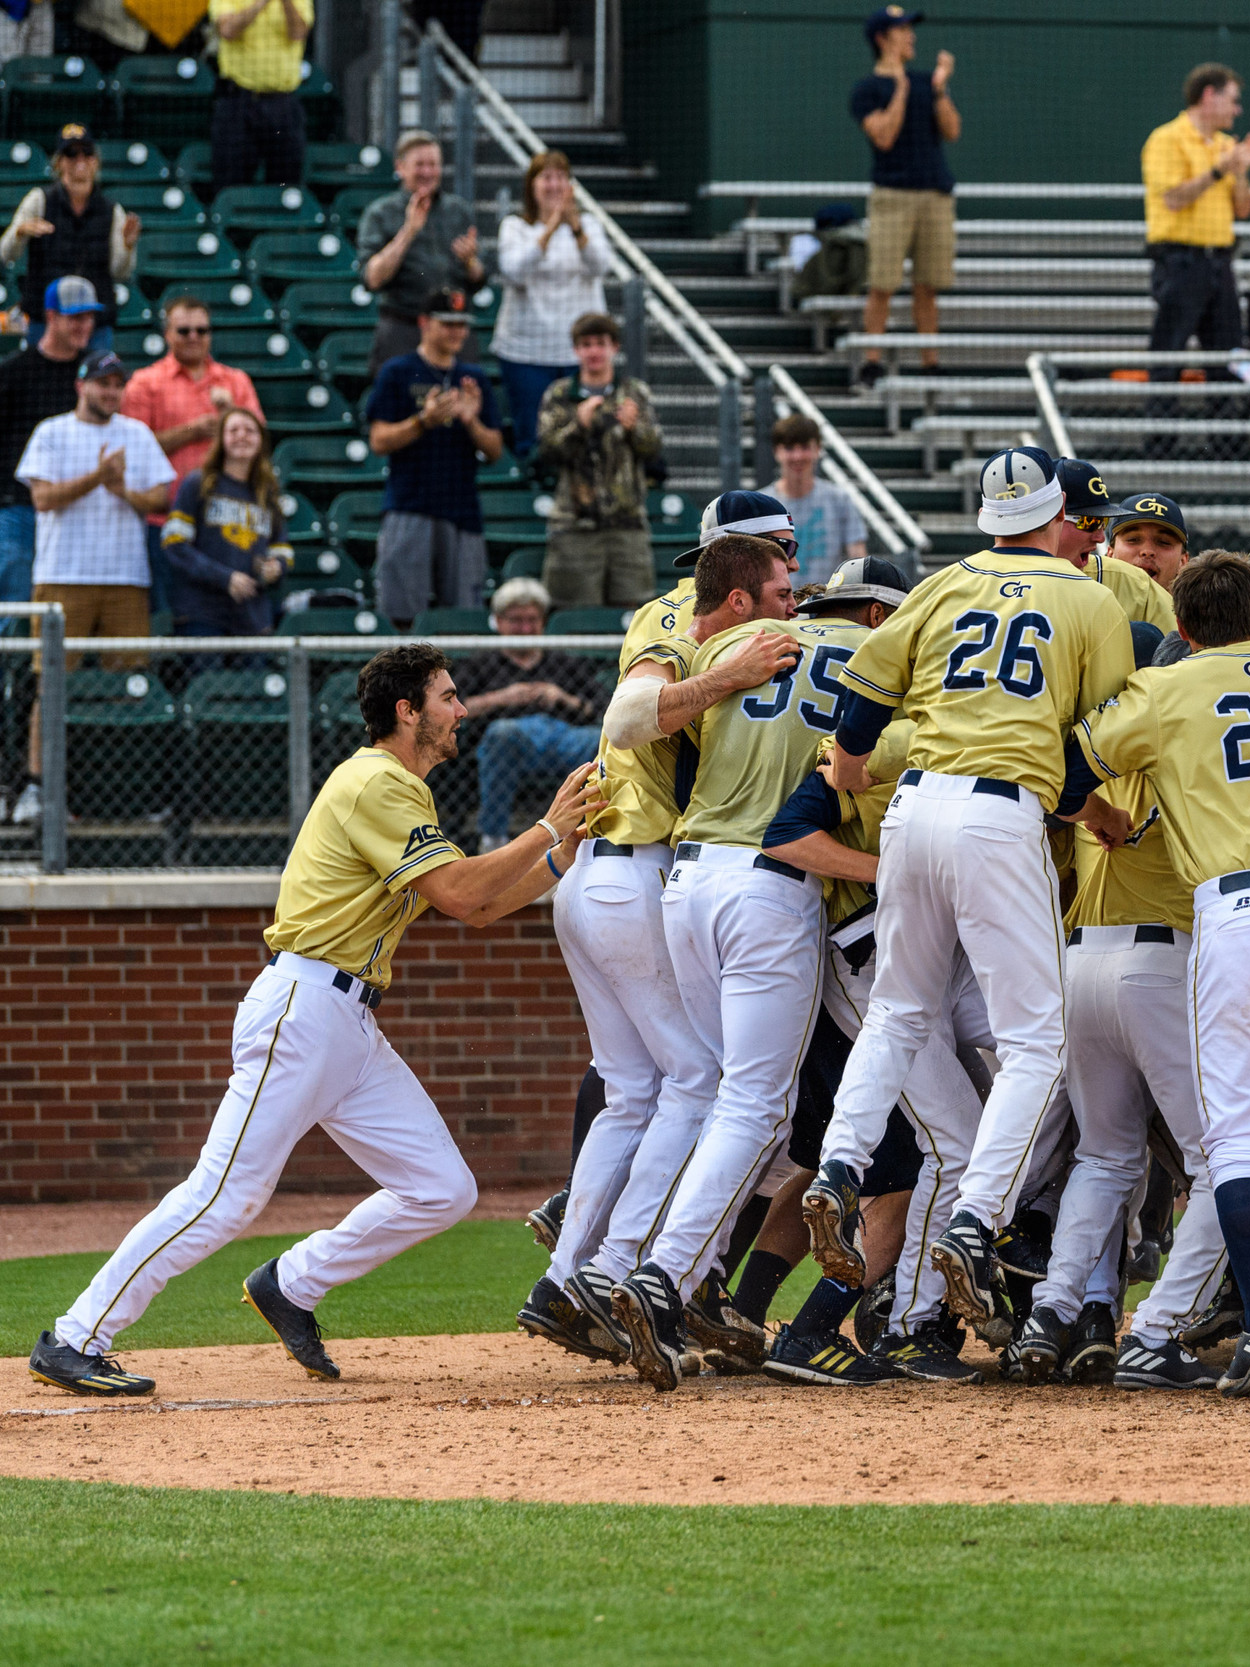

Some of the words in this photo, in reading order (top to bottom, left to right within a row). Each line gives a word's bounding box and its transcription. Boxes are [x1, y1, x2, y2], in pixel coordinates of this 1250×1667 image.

[1135, 498, 1168, 516] GT
[1000, 581, 1032, 598] GT
[661, 613, 676, 632] G
[942, 608, 1054, 700] 26
